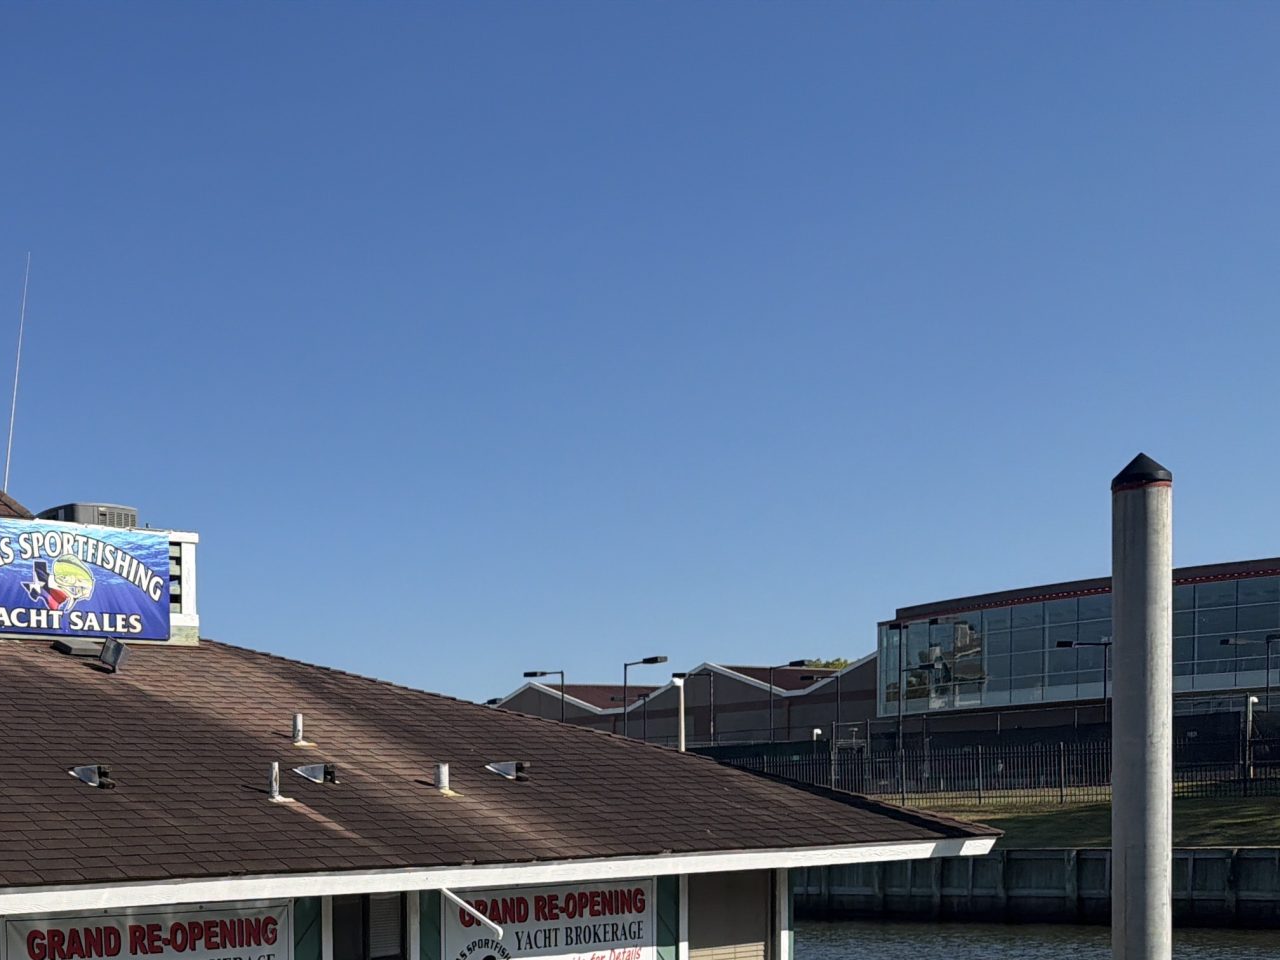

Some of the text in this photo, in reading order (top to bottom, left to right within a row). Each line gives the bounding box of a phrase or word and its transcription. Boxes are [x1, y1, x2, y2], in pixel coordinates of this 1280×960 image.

[19, 531, 165, 601] SPORTFISHING
[70, 612, 142, 634] SALES
[459, 888, 646, 927] GRAND RE-OPENING
[129, 916, 277, 954] RE-OPENING
[515, 921, 644, 950] YACHT BROKERAGE
